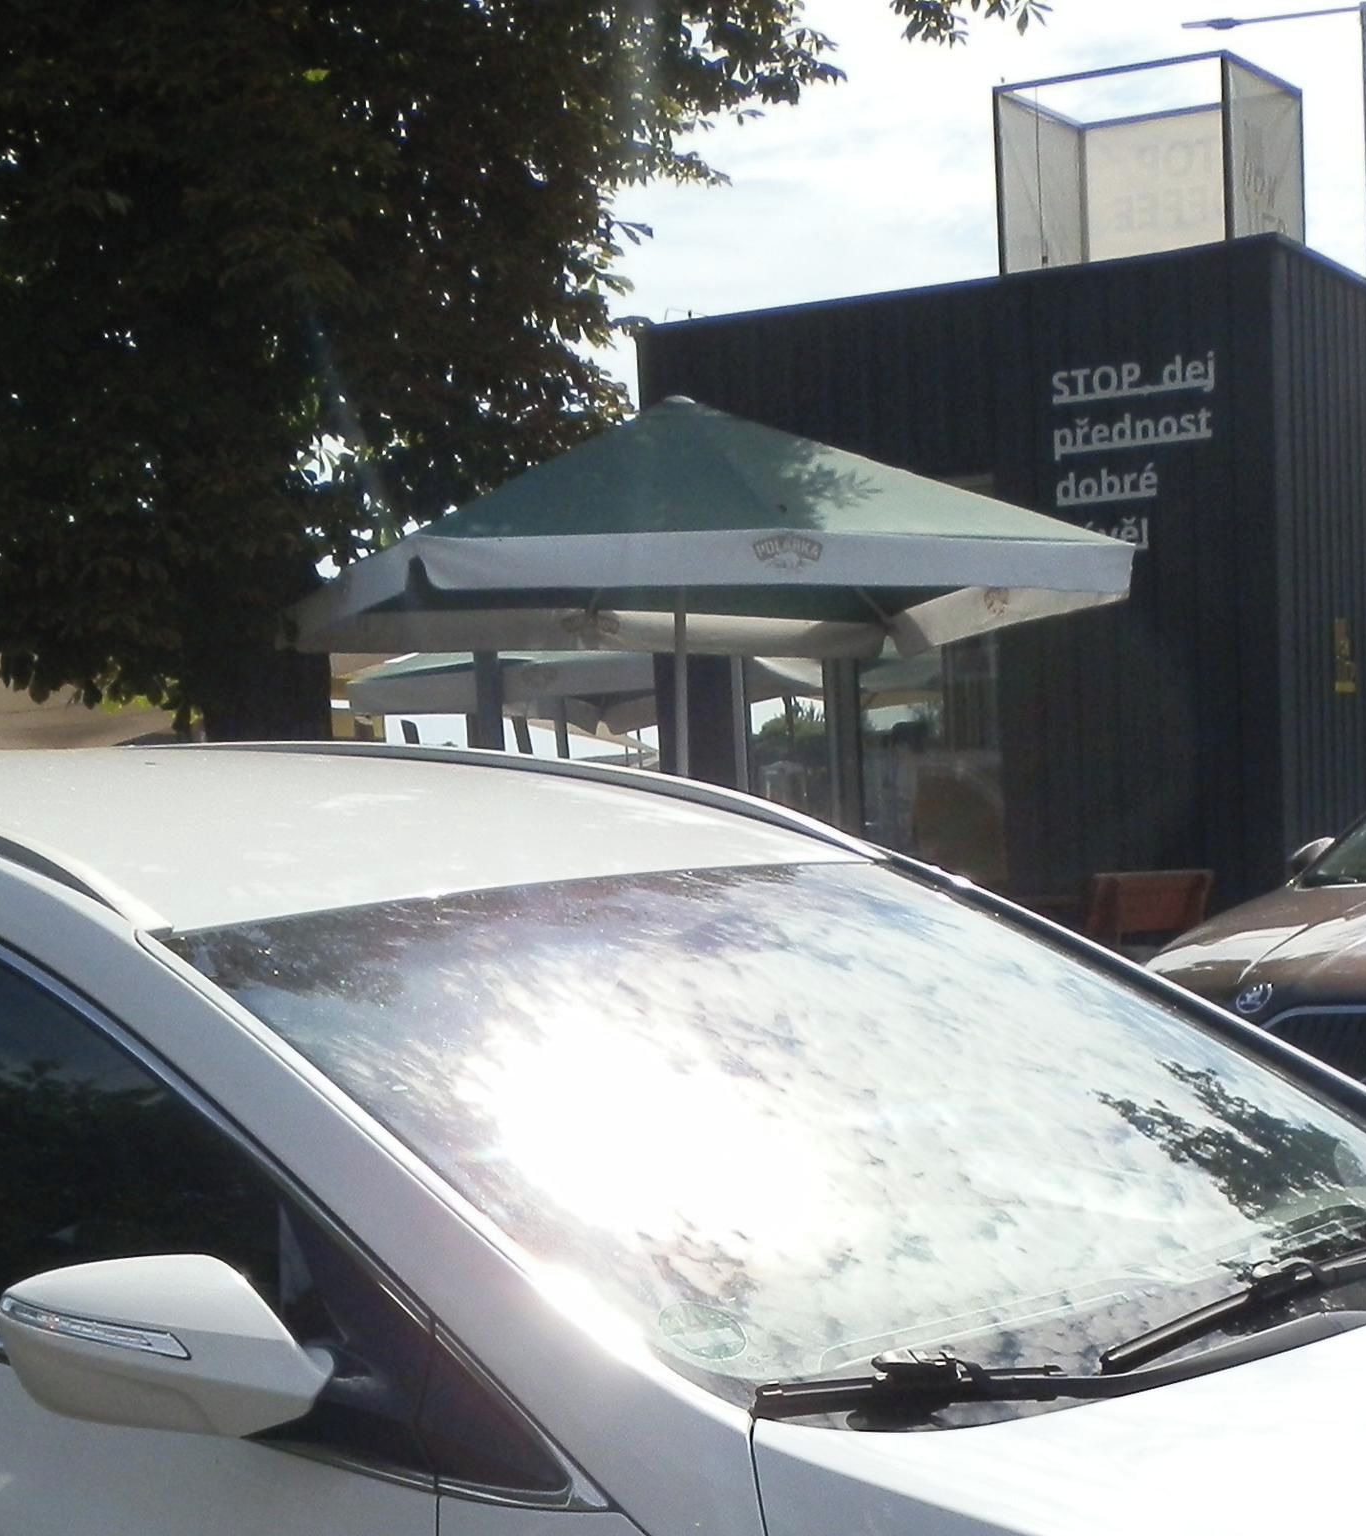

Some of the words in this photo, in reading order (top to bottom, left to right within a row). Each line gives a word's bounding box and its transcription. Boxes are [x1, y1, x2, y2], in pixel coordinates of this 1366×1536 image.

[1163, 350, 1215, 392] dej
[1053, 408, 1213, 461] přednost
[1056, 463, 1158, 506] dobré
